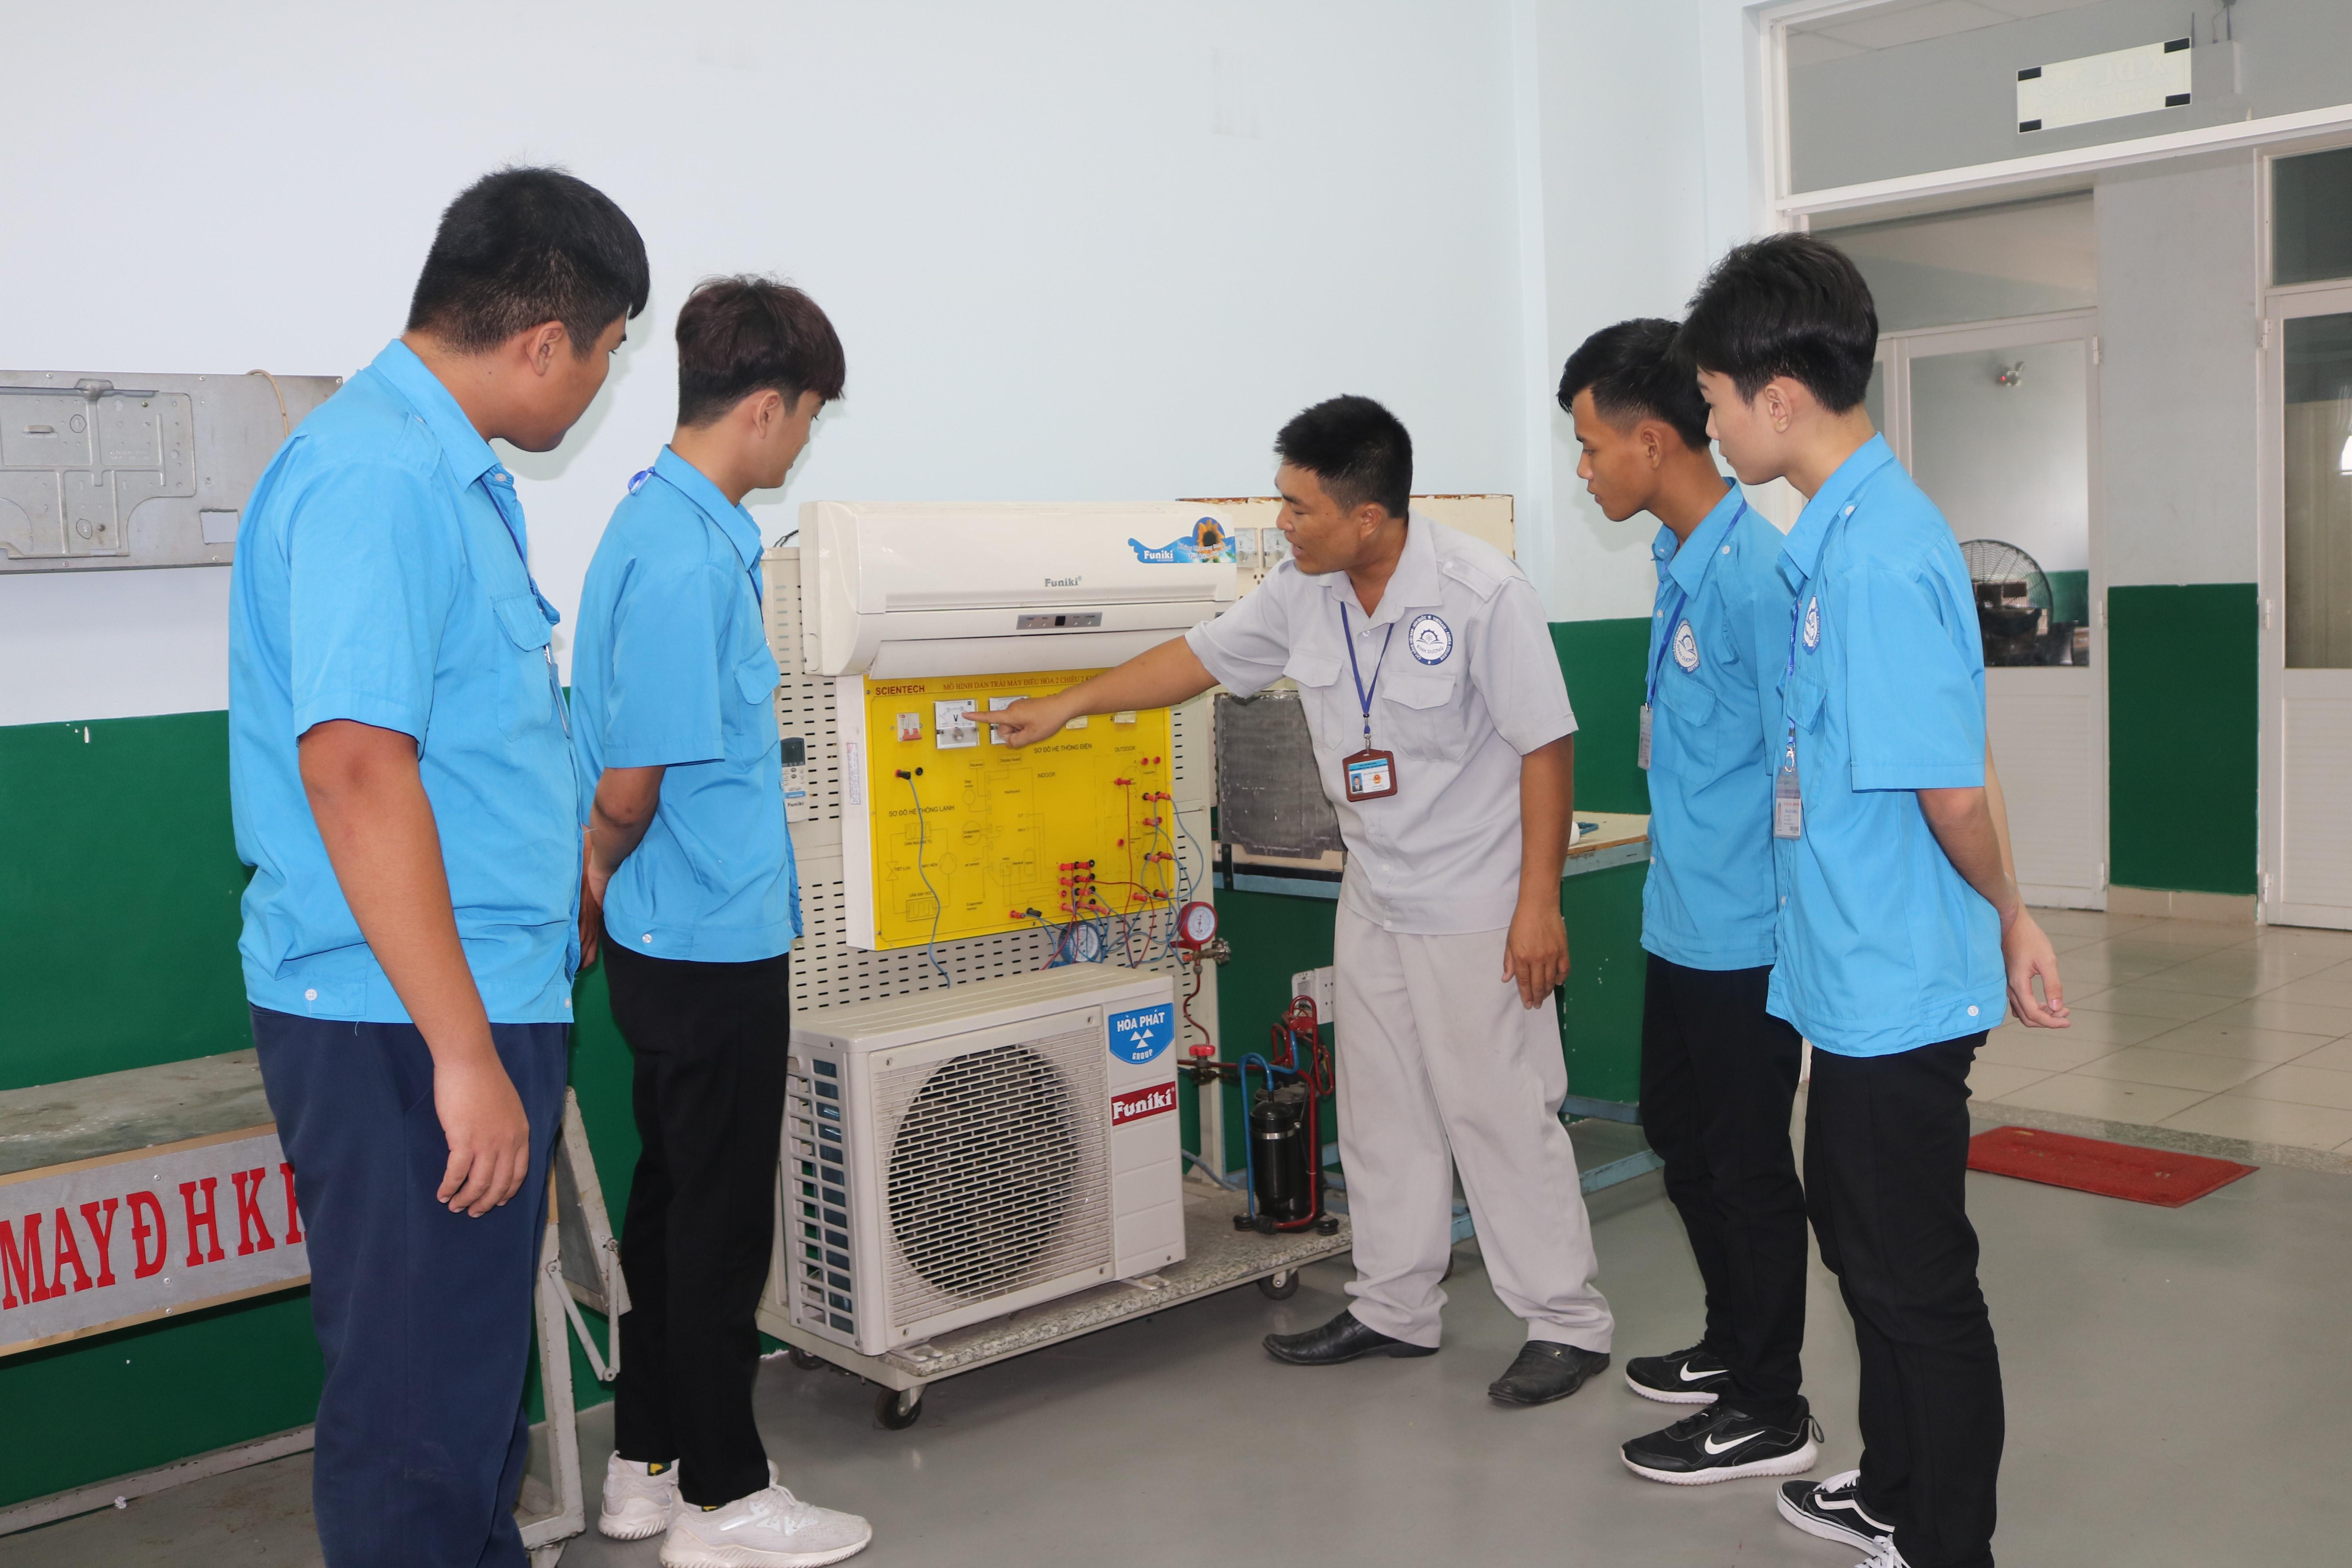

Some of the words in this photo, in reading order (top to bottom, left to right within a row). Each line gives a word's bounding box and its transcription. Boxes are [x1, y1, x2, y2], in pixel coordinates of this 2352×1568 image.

[1143, 550, 1173, 559] Funiki
[1044, 577, 1078, 587] Funiki
[956, 681, 972, 690] HÌNH
[1007, 678, 1022, 686] MÁY
[1024, 677, 1039, 685] ĐIỀU
[876, 685, 925, 695] SCIENTECH
[1117, 1015, 1138, 1032] HÒA
[1140, 1009, 1165, 1028] PHÁT
[1132, 1049, 1153, 1060] GROUP
[1112, 1088, 1172, 1120] Funiki
